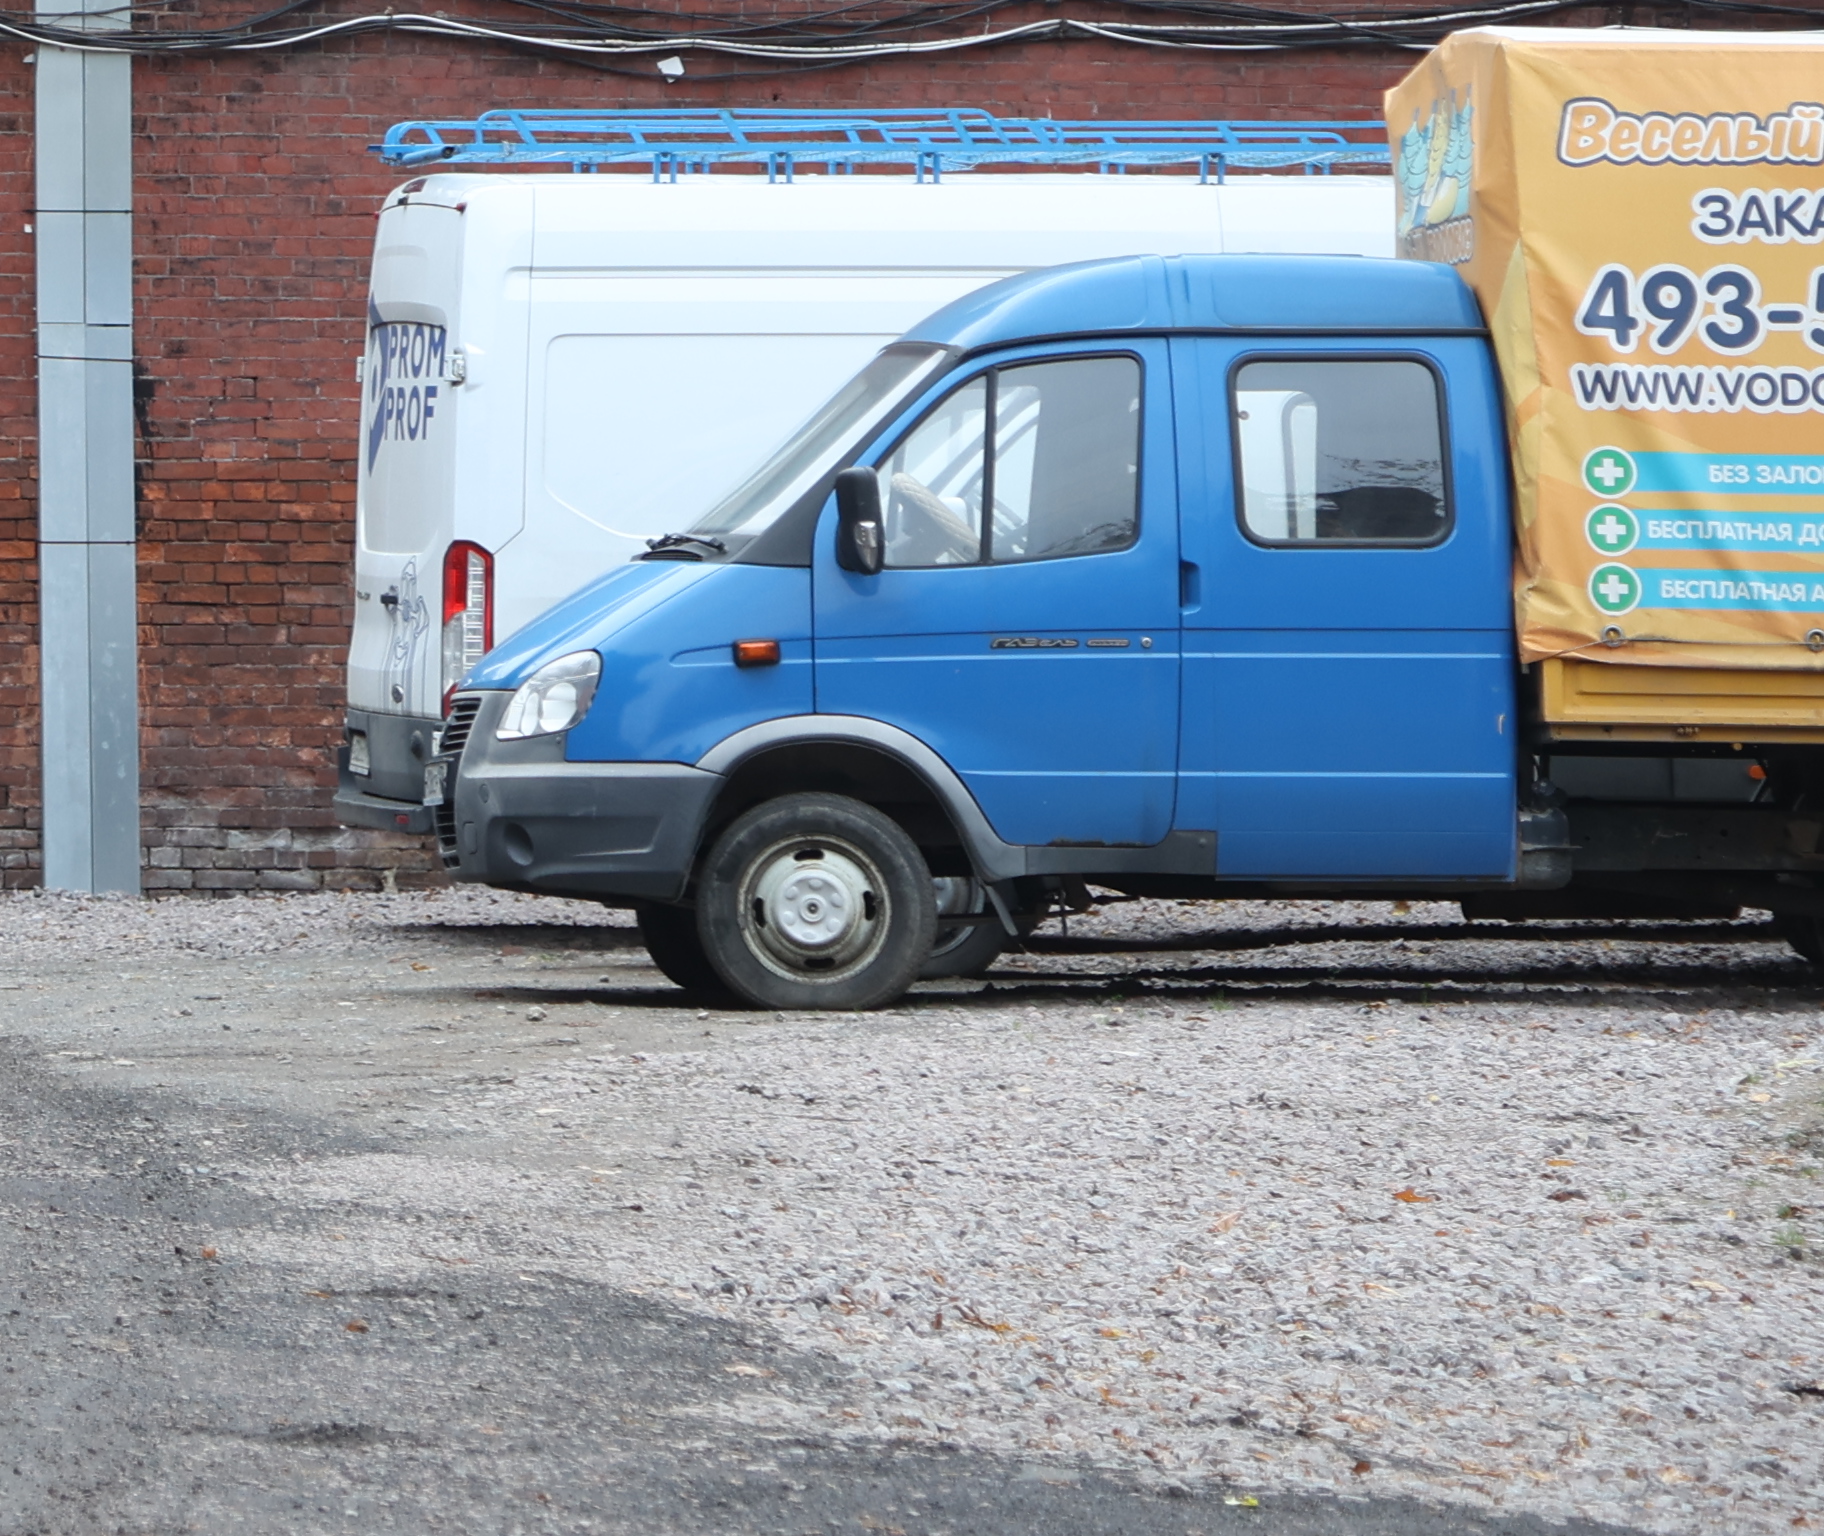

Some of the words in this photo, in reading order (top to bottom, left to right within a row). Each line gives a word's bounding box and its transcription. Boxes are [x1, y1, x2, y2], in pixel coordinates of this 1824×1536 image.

[1557, 97, 1824, 167] Веселый
[1579, 267, 1824, 352] 493-
[388, 324, 447, 379] PROM
[384, 385, 439, 441] PROF
[1708, 464, 1750, 484] БЕЗ
[1756, 465, 1824, 485] ЗАЛО
[1647, 520, 1793, 542] БЕСПЛАТНАЯ
[1660, 579, 1807, 603] БЕСПЛАТНАЯ
